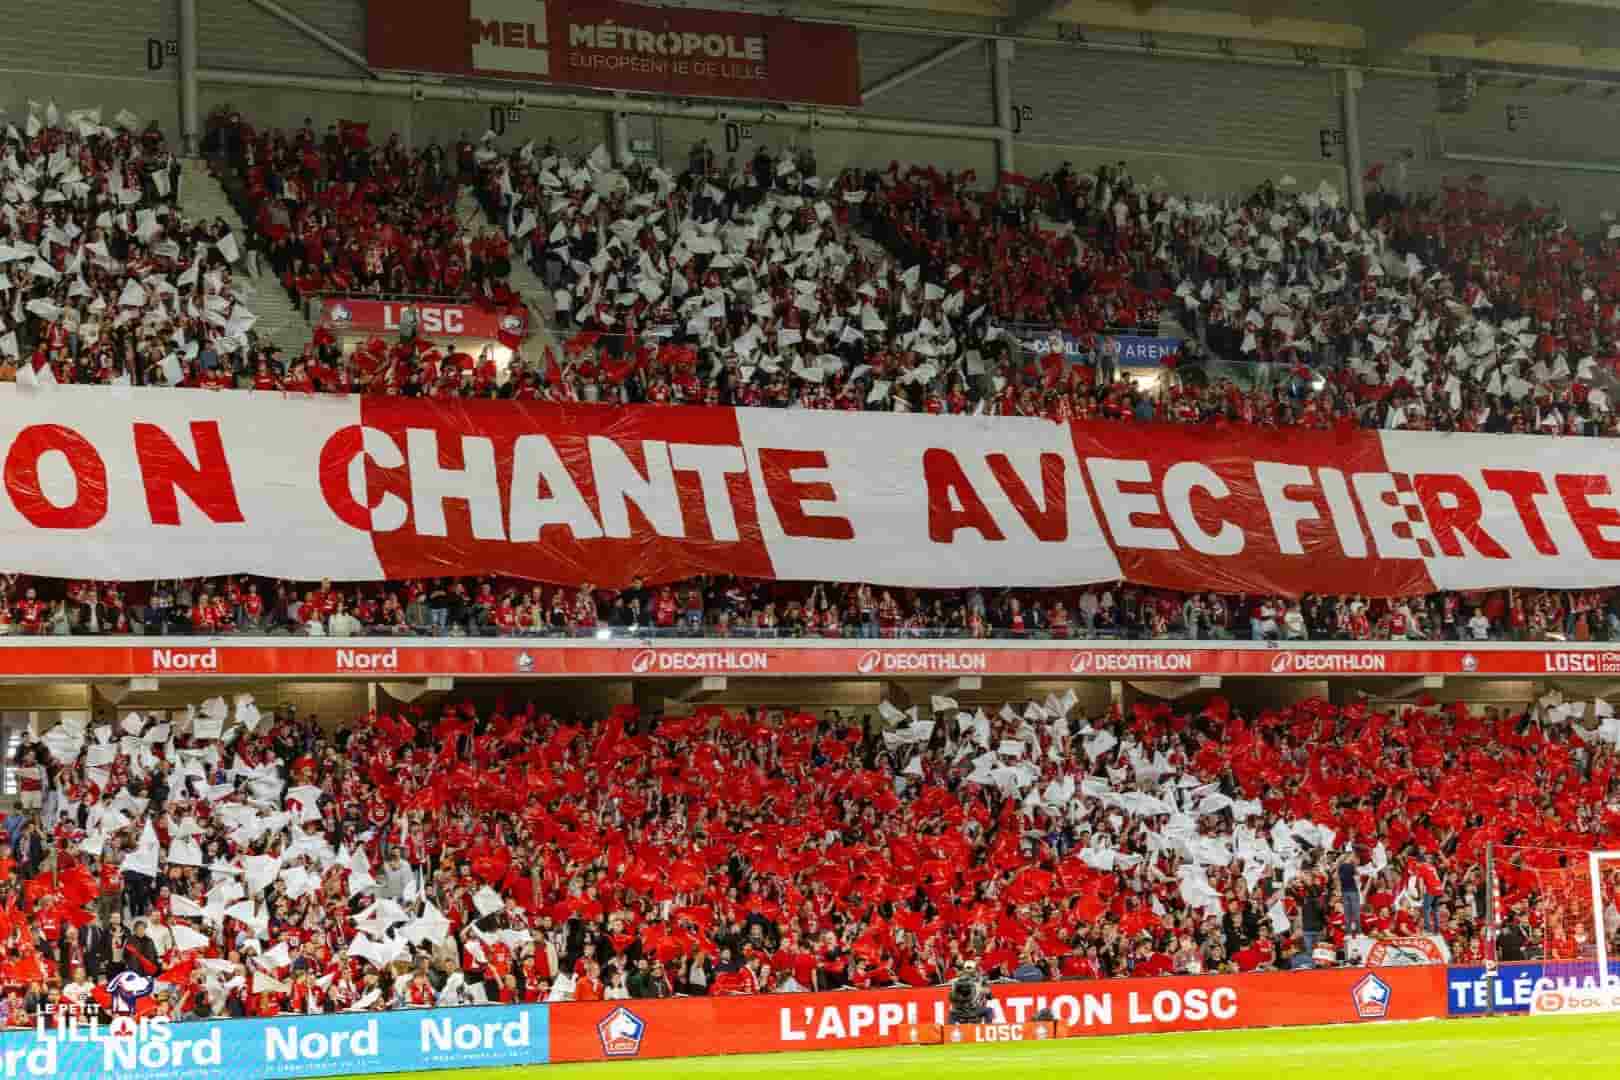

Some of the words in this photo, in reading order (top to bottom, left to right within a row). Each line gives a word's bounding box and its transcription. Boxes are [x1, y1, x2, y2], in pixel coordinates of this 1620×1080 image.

[473, 19, 549, 49] MEL
[569, 20, 765, 60] MÉTROPOLE
[4, 421, 244, 530] ON
[319, 423, 854, 543] CHANTE
[923, 448, 1247, 557] AVEC
[1253, 460, 1620, 561] FIERTE
[152, 648, 218, 669] Nord
[336, 648, 398, 669] Nord
[659, 652, 767, 670] DECATHLON
[883, 652, 985, 670] DECATHLON
[1095, 652, 1192, 670] DECATHLON
[1294, 652, 1386, 670] DECATHLON
[1545, 653, 1596, 671] LOSC
[780, 994, 1112, 1040] L'APPLIATION
[1128, 987, 1237, 1024] LOSC
[265, 1020, 379, 1061] Nord
[420, 1012, 530, 1053] Nord
[976, 1024, 1024, 1042] LOSC
[104, 1027, 222, 1072] Nord
